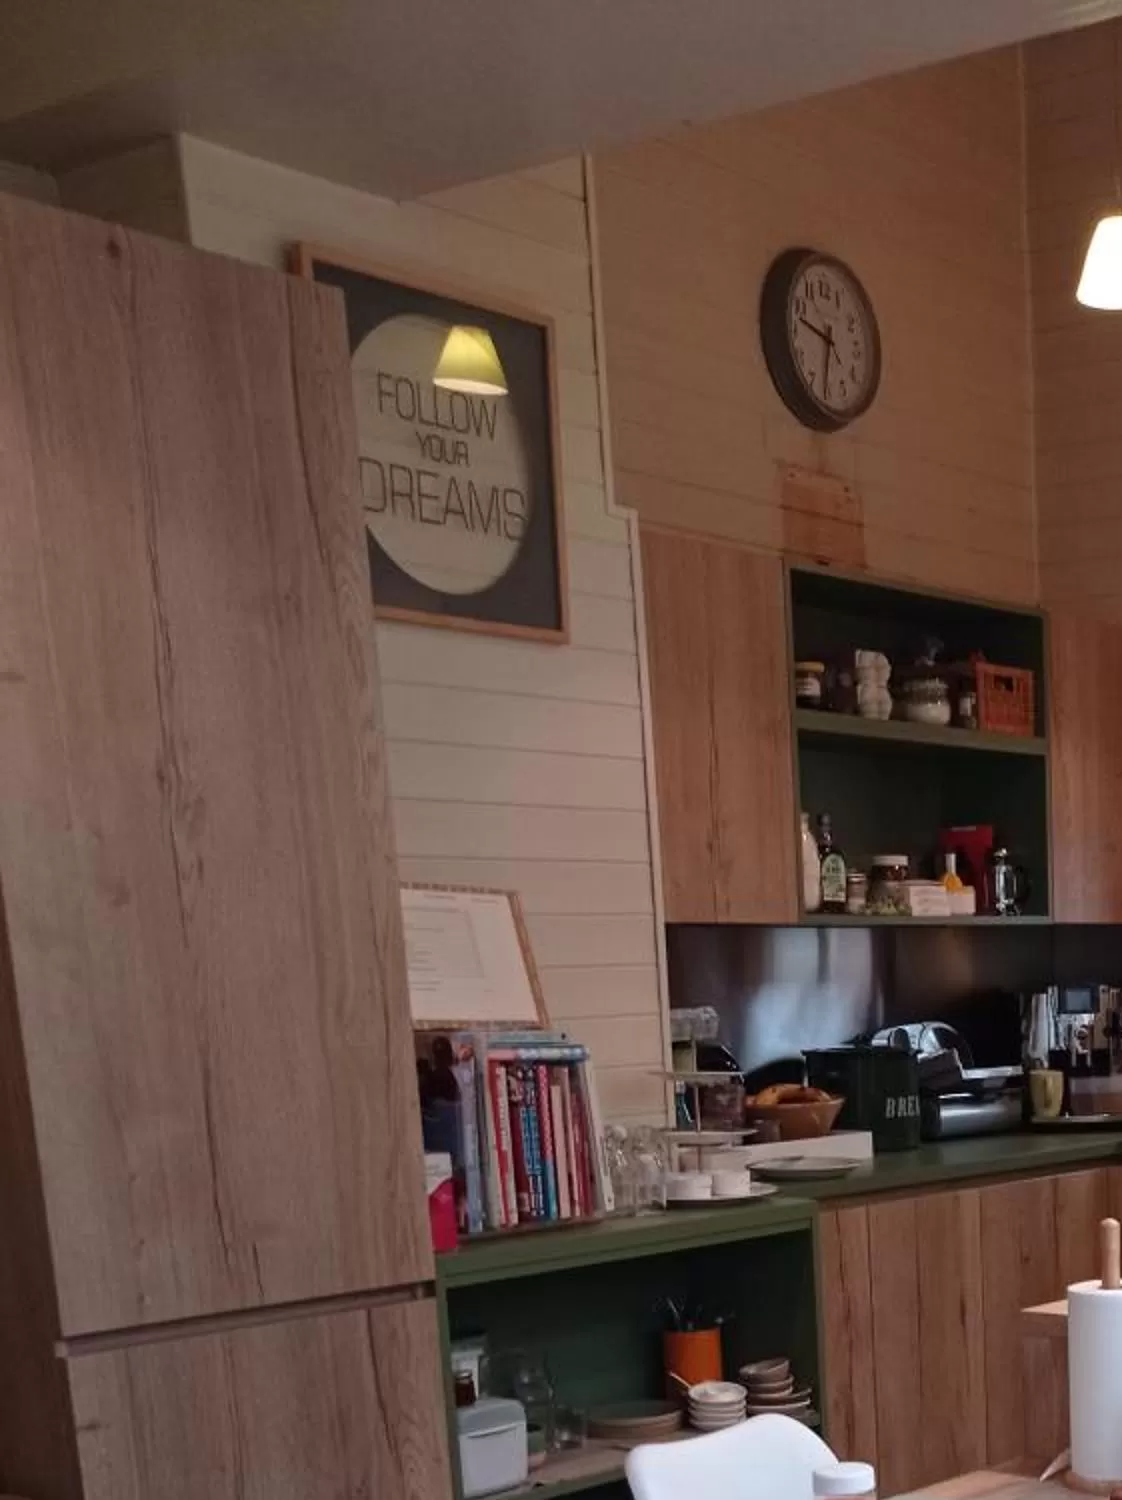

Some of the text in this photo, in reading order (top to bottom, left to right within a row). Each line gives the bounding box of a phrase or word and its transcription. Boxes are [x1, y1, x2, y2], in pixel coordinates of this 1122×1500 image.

[377, 369, 498, 441] FOLLOW
[415, 430, 471, 468] YOUR
[358, 456, 528, 541] DREAMS
